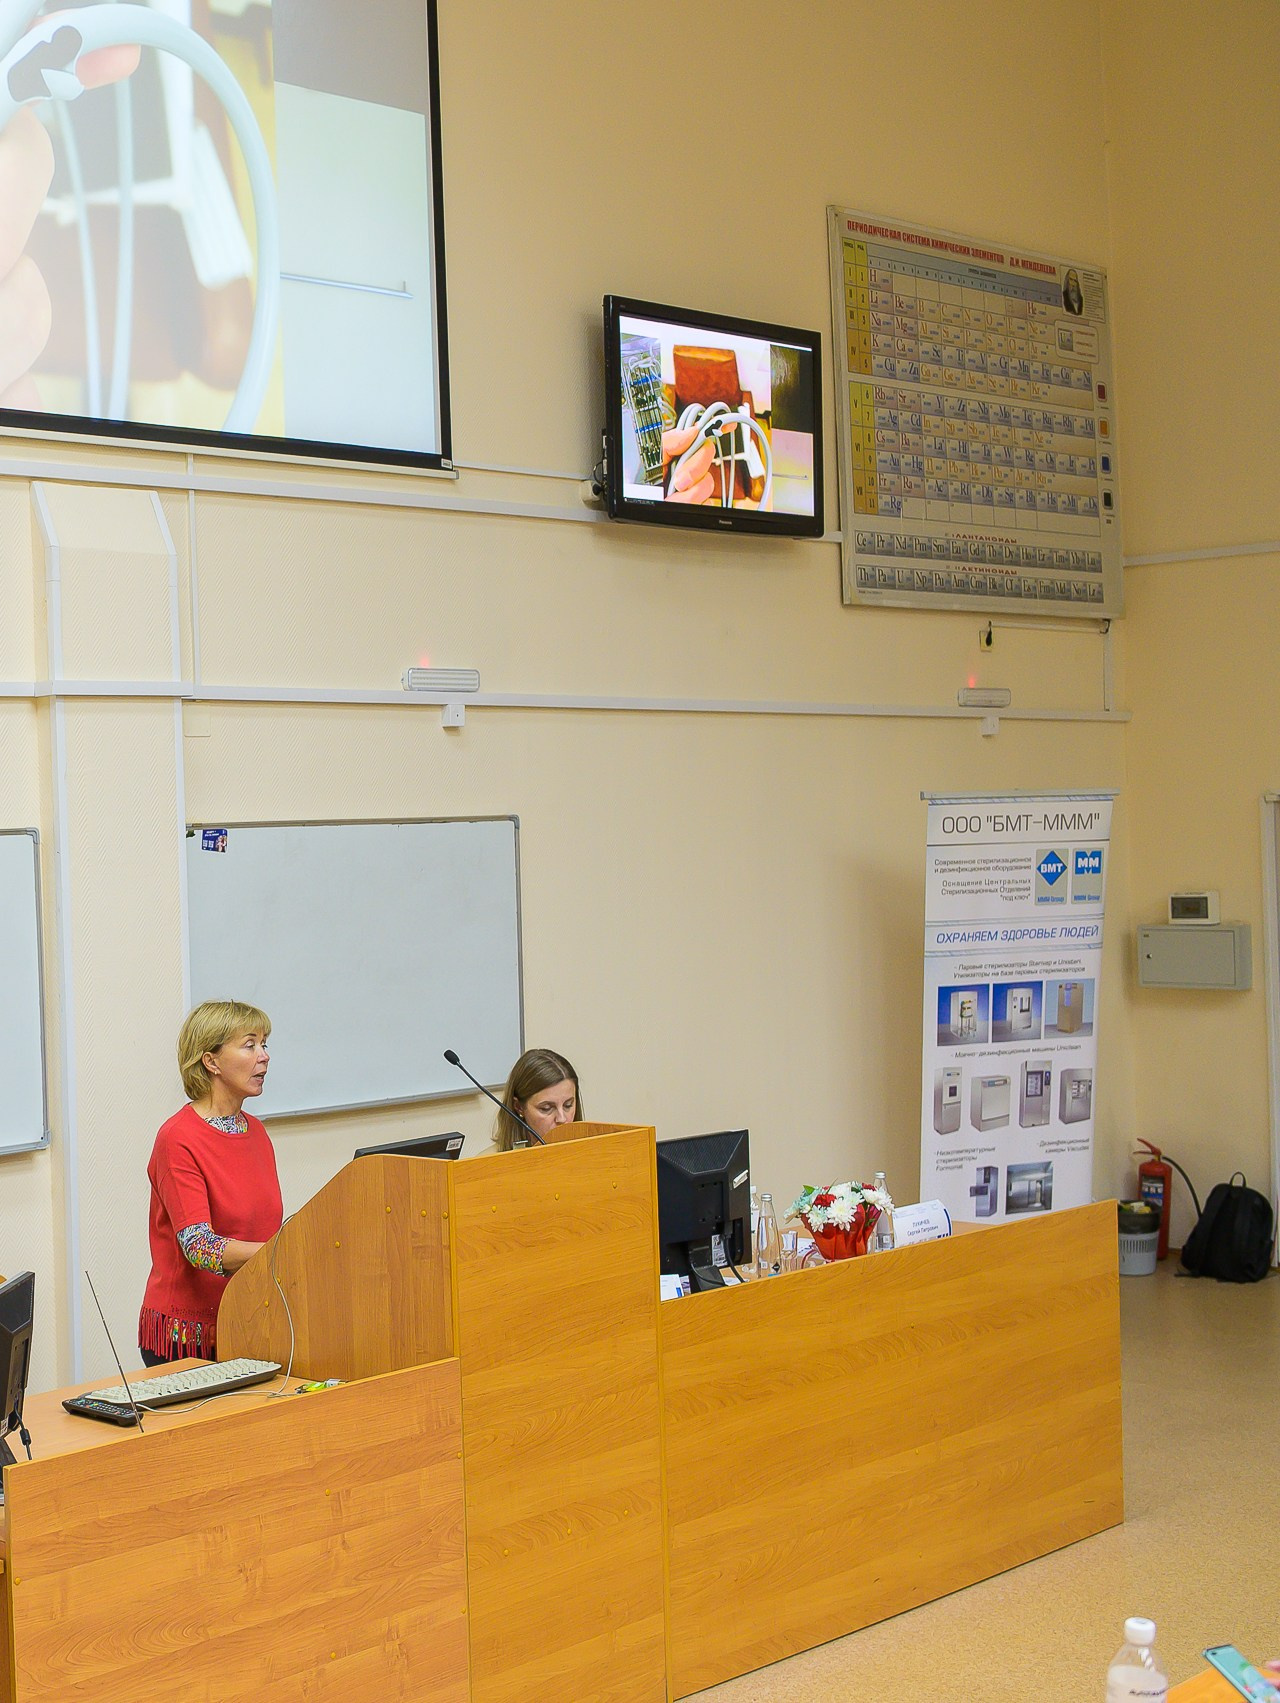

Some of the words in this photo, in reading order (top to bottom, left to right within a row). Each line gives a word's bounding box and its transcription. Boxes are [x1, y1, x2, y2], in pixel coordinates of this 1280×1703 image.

[847, 220, 901, 240] ПЕРИОДИЧЕСКАЯ
[902, 232, 930, 247] СИСТЕМА
[870, 291, 878, 304] Li
[872, 334, 879, 347] K
[897, 339, 905, 352] Ca
[885, 358, 894, 371] Cu
[909, 362, 919, 375] Zn
[875, 386, 885, 400] Rb
[911, 414, 921, 427] Cd
[876, 430, 885, 443] Cs
[912, 456, 923, 470] Hg
[903, 476, 912, 489] Ra
[890, 496, 901, 511] Rg
[896, 536, 906, 550] Nd
[914, 538, 926, 551] Pm
[933, 540, 944, 553] Sm
[858, 568, 869, 581] Th
[878, 569, 886, 582] Pa
[916, 572, 926, 587] Np
[935, 573, 944, 586] Pu
[952, 574, 964, 587] Am
[942, 816, 982, 834] ООО
[1040, 863, 1063, 873] BMT
[1077, 857, 1099, 868] MM
[936, 930, 998, 944] ОХРАНЯЕМ
[1001, 927, 1057, 942] ЗДОРОВЬЕ
[1059, 925, 1099, 939] ЛЮДЕЙ
